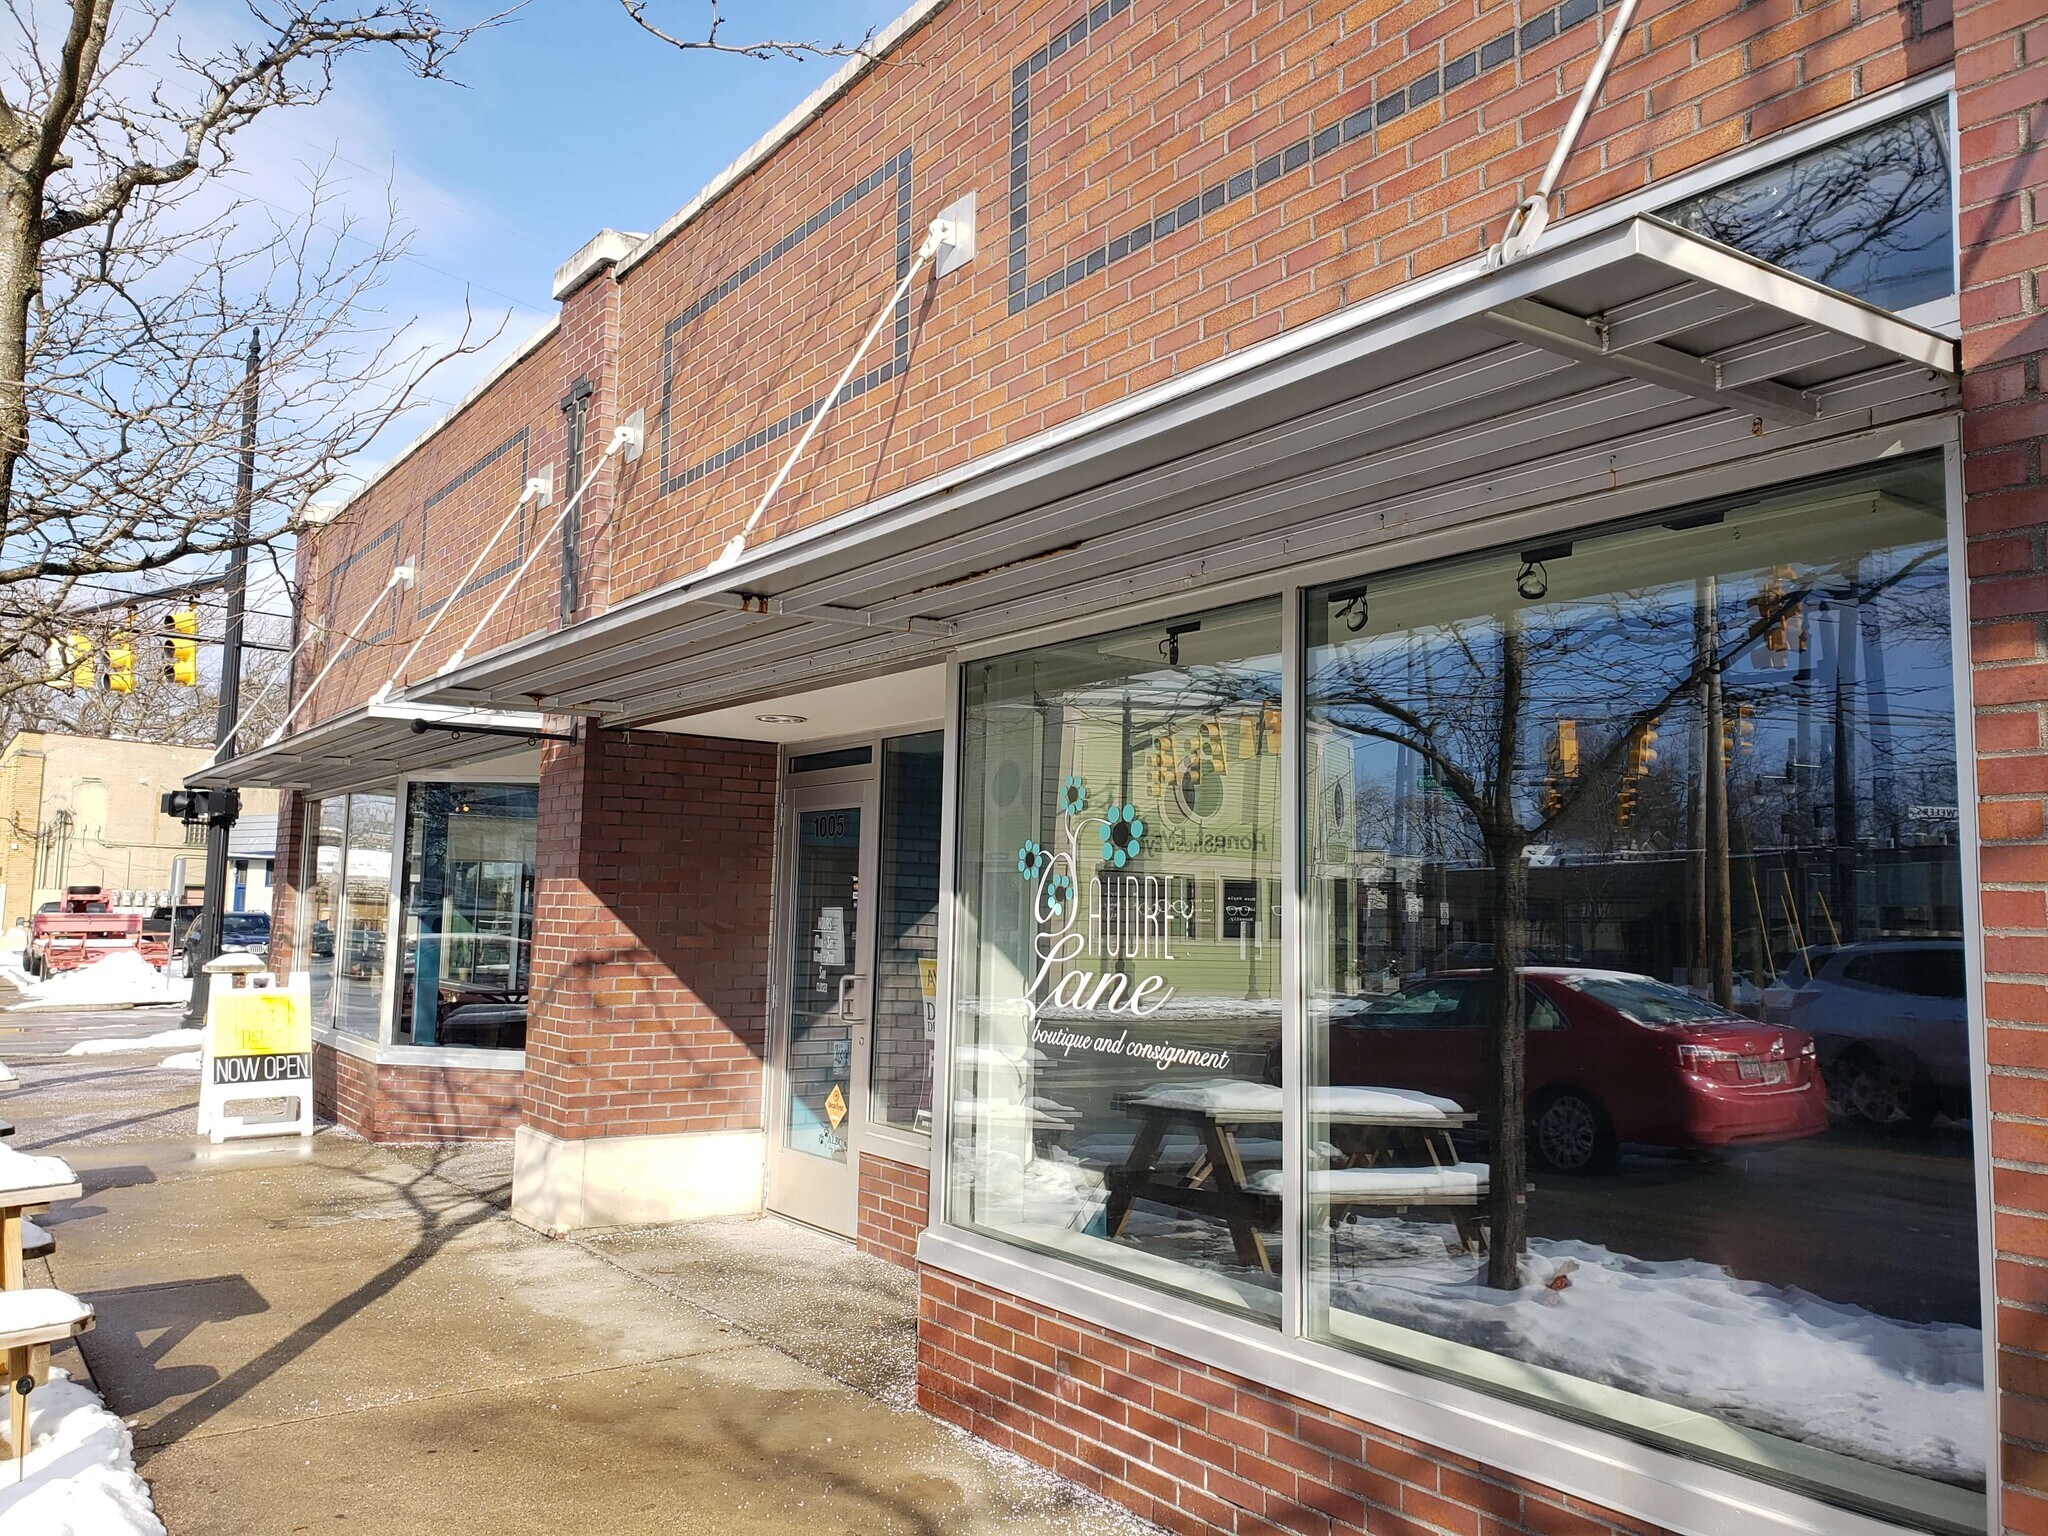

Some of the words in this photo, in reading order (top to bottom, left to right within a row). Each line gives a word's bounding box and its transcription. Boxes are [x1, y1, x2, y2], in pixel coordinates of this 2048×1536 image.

[814, 814, 845, 838] 1005
[1087, 875, 1194, 960] AUDREY
[1006, 932, 1175, 1021] Lane
[216, 1057, 260, 1083] NOW
[264, 1054, 309, 1080] OPEN
[1031, 1018, 1093, 1056] boutique
[1093, 1029, 1126, 1055] and
[1126, 1038, 1230, 1071] consignment
